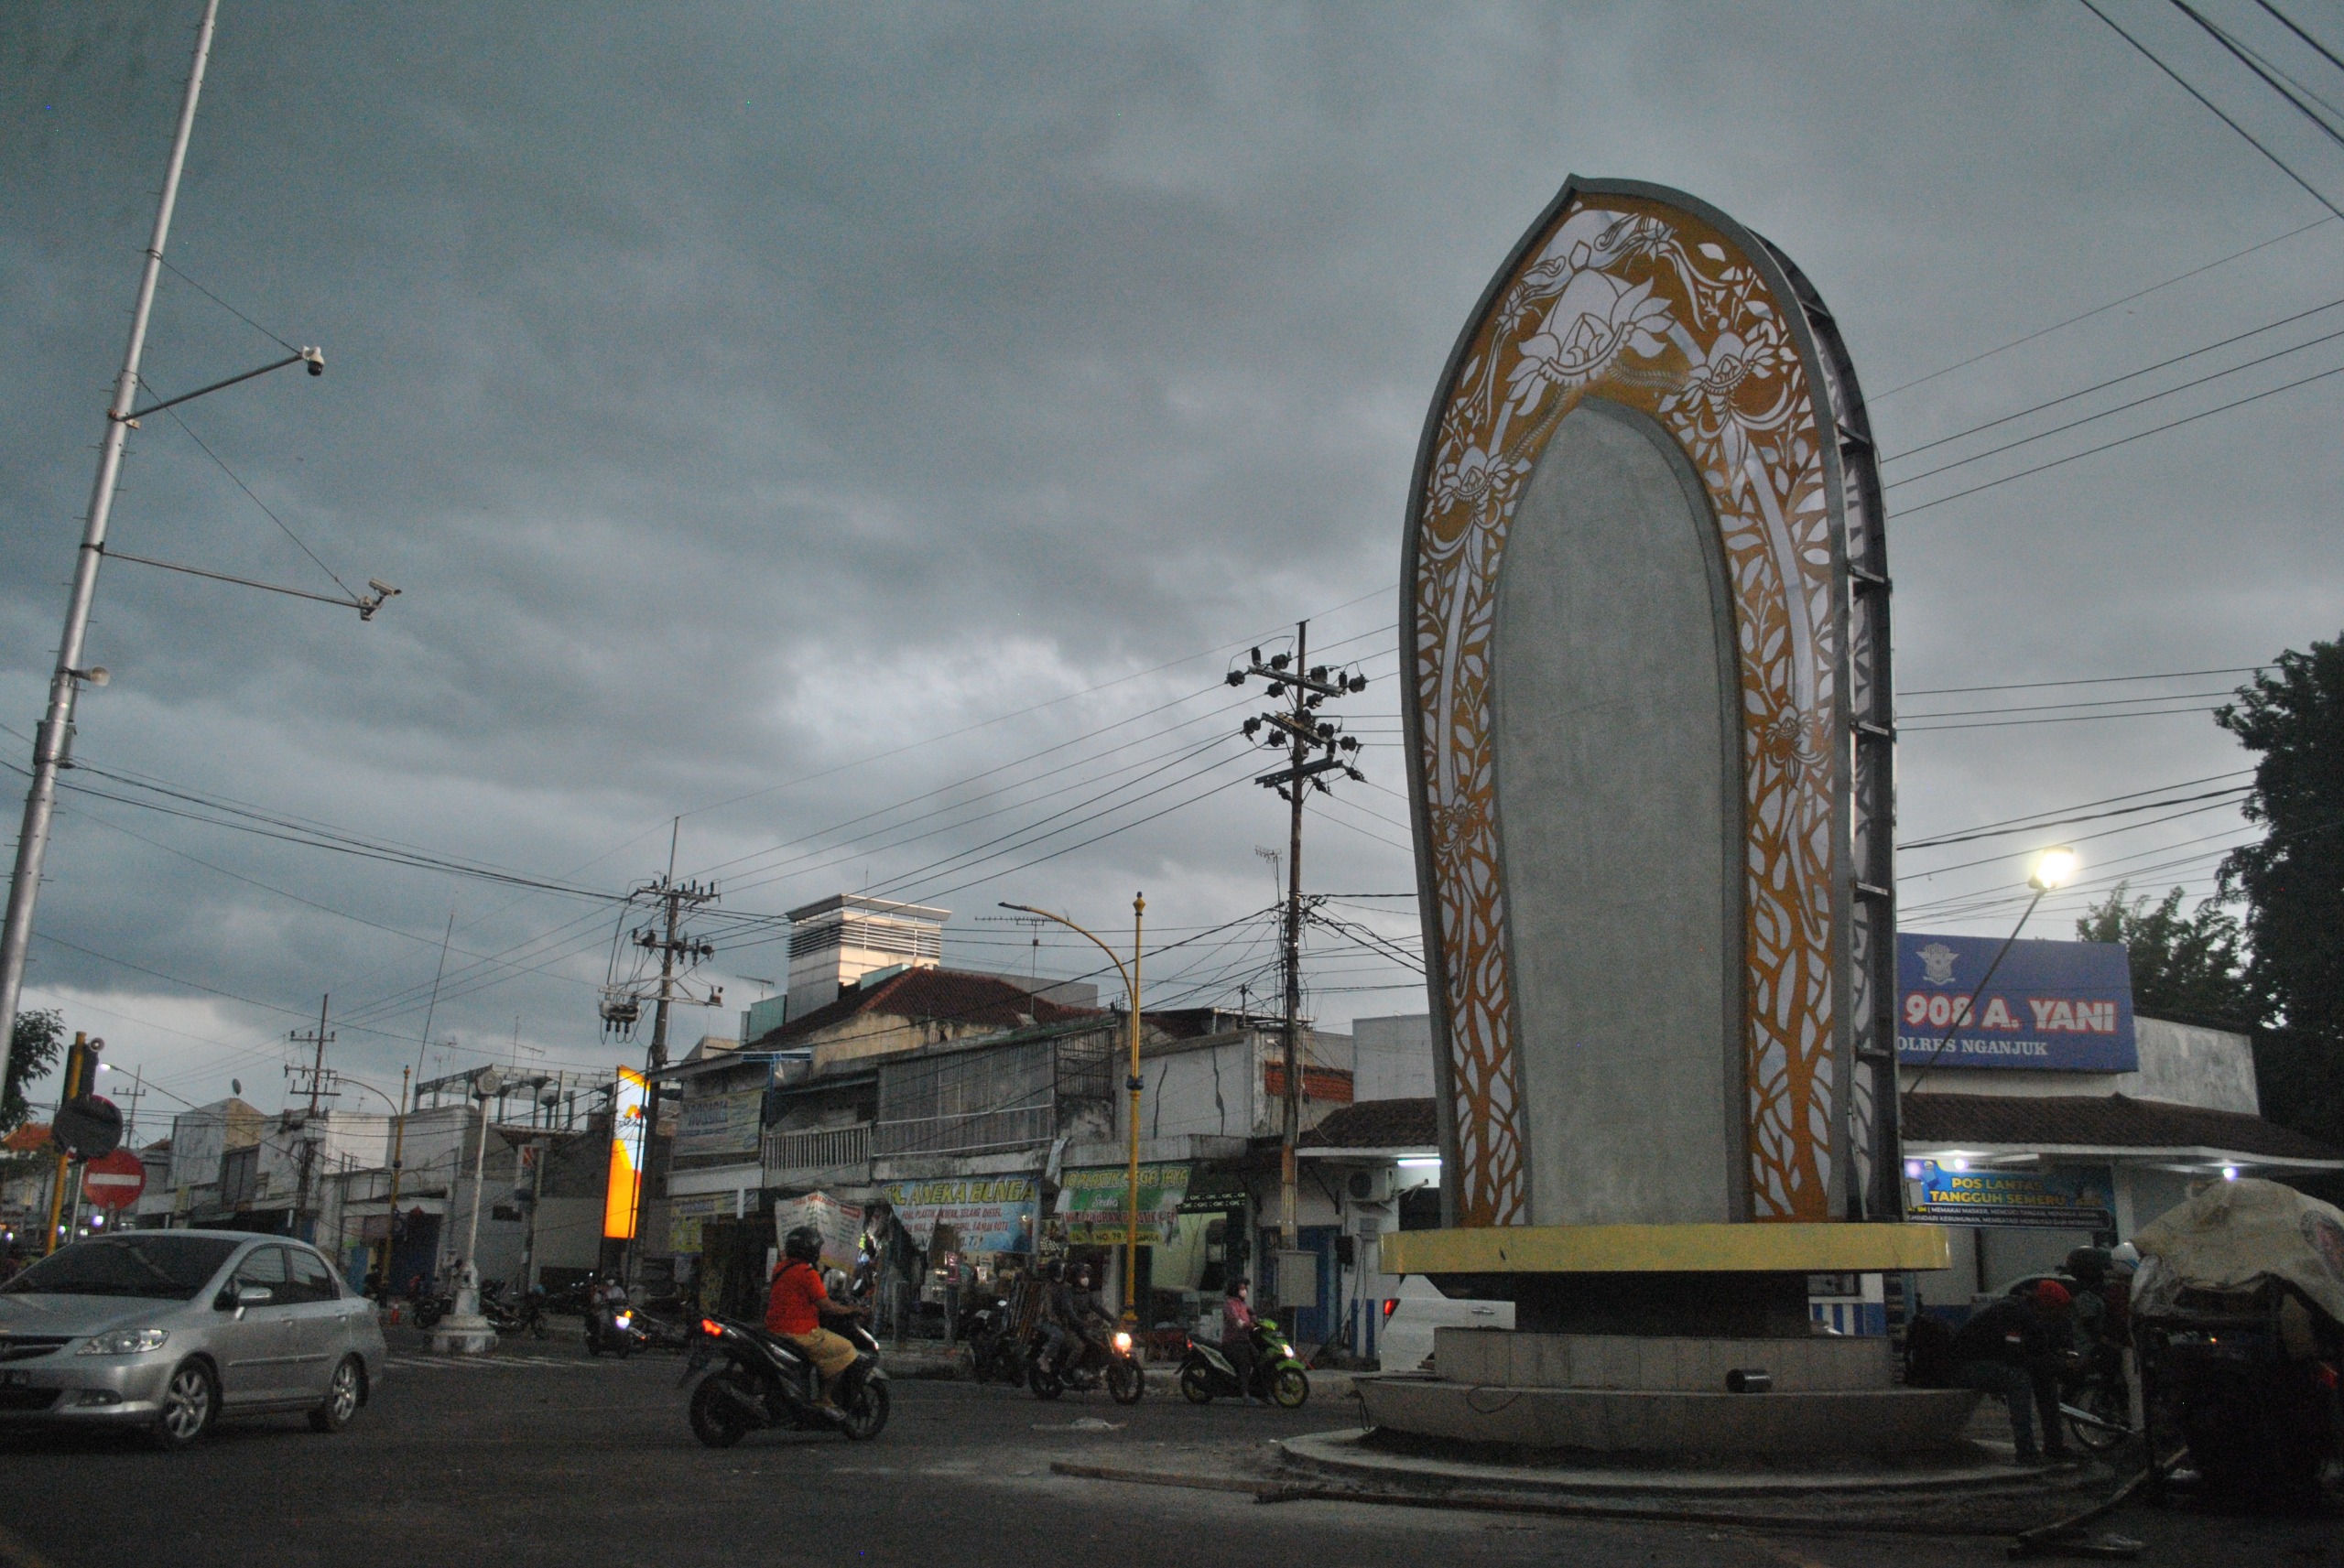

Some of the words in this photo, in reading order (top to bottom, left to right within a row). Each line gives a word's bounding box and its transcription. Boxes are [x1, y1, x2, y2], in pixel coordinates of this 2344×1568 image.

[1905, 993, 1975, 1028] 908
[1981, 998, 2020, 1029] A.
[2030, 1000, 2115, 1033] YANI
[1897, 1036, 1956, 1053] OLRES
[1960, 1040, 2047, 1055] NGANJUK
[909, 1183, 966, 1205] ANEKA
[968, 1179, 1036, 1204] BUNGA
[1951, 1178, 1981, 1189] POS
[1091, 1193, 1119, 1208] Sedia
[1929, 1190, 2002, 1203] TANGGUH
